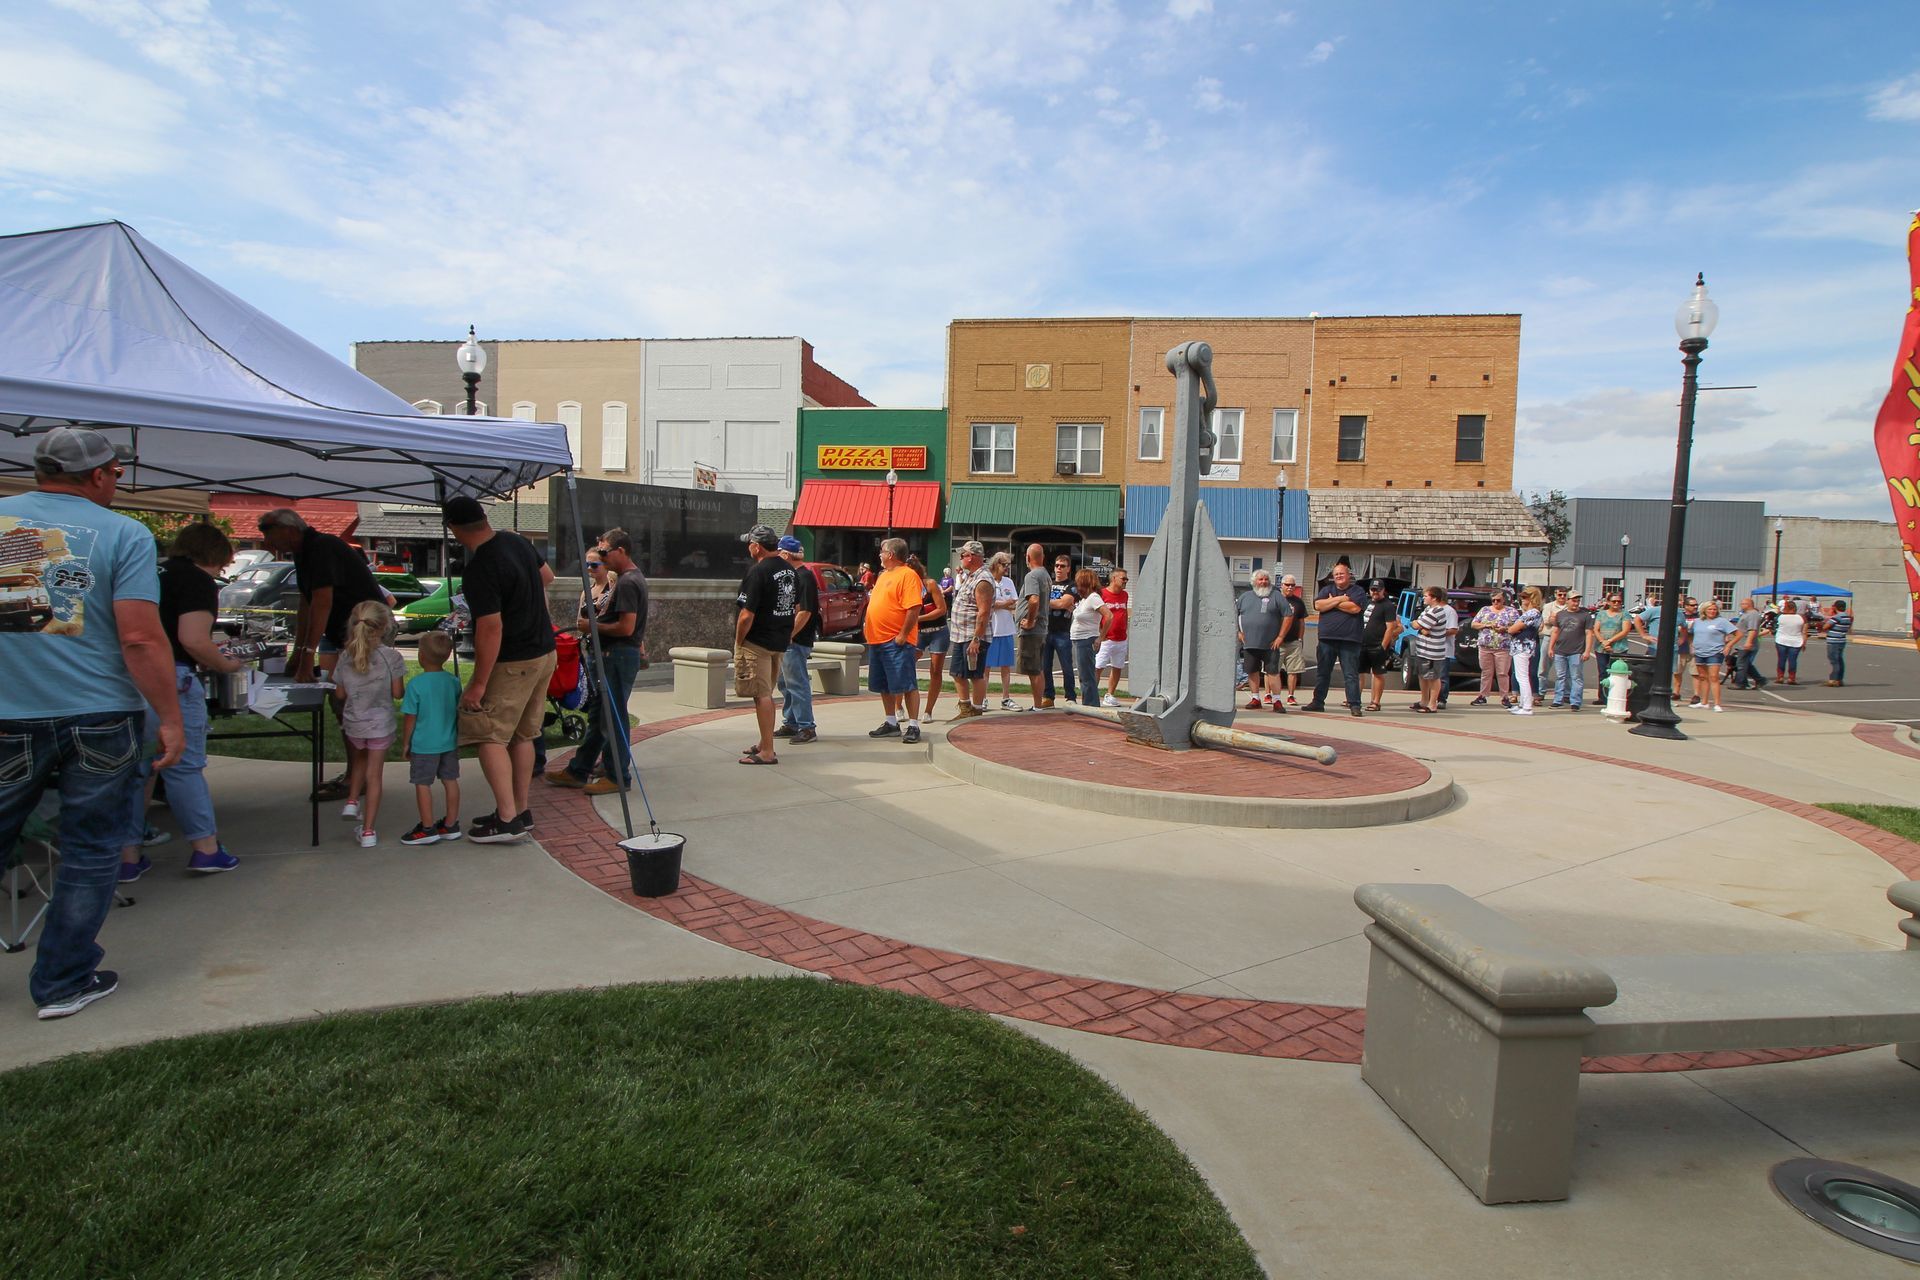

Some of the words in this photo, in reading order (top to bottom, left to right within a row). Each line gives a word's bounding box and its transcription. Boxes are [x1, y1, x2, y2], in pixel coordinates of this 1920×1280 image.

[823, 448, 885, 457] PIZZA
[821, 458, 888, 467] WORKS
[602, 491, 664, 508] VETERANS
[667, 497, 722, 513] MEMORIAL
